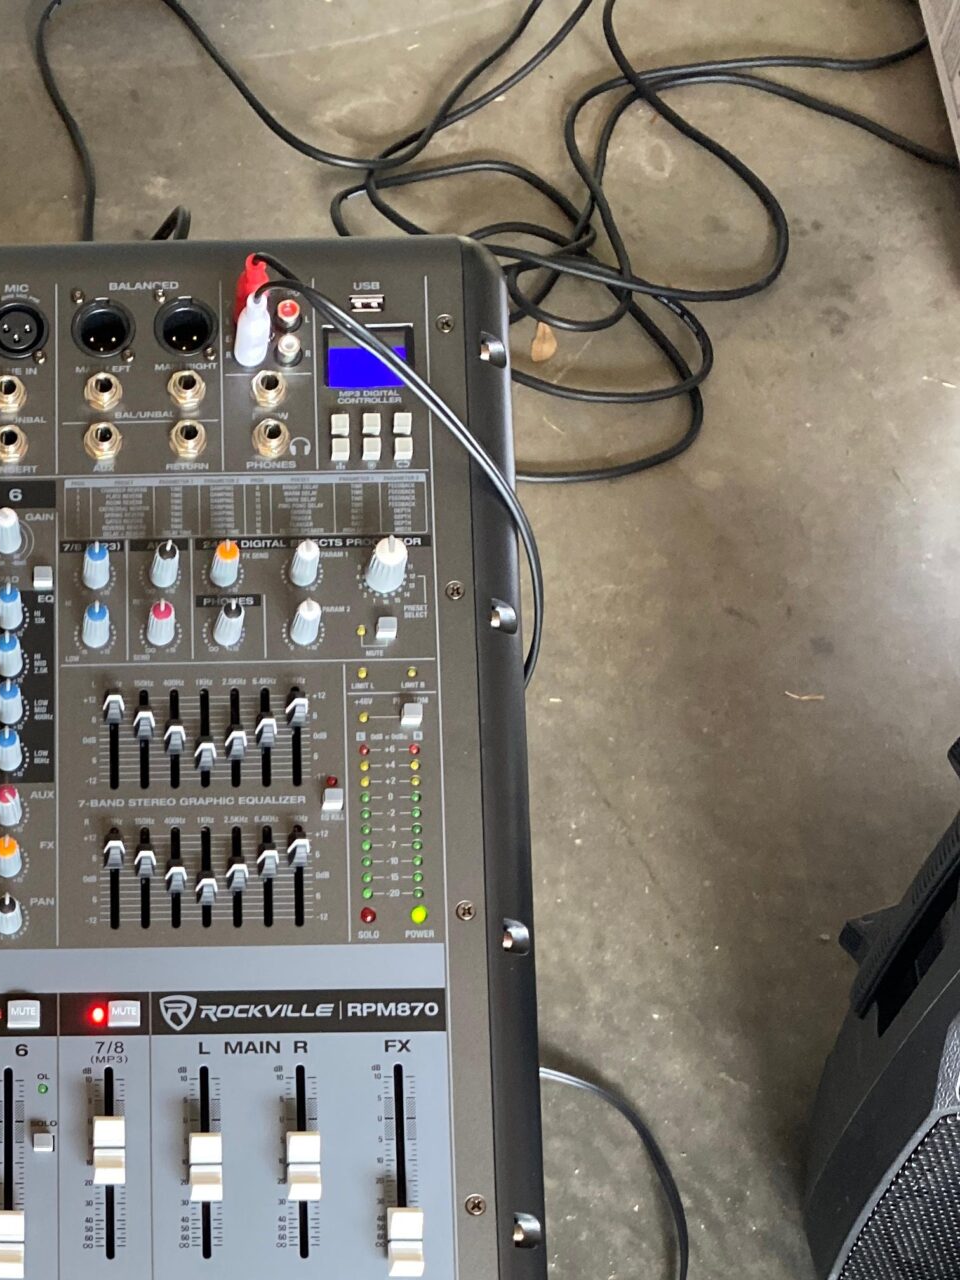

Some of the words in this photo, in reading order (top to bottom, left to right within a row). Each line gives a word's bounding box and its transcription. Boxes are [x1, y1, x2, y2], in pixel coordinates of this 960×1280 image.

[4, 284, 29, 293] MIC
[108, 281, 179, 291] BALANCED
[353, 281, 380, 290] USB
[339, 390, 361, 398] MP3
[362, 390, 399, 398] DIGITAL
[337, 396, 402, 404] CONTROLLER
[93, 463, 115, 472] AUX
[165, 462, 209, 471] RETURN
[246, 461, 296, 470] PHONES
[9, 489, 22, 501] 6
[25, 513, 54, 521] GAIN
[241, 539, 286, 548] DIGITAL
[37, 595, 54, 604] EQ
[30, 790, 54, 799] AUX
[78, 798, 125, 808] 7-BAND
[128, 797, 176, 807] STEREO
[179, 796, 235, 806] GRAPHIC
[238, 795, 306, 805] EQUALIZER
[40, 841, 54, 849] FX
[29, 897, 55, 906] PAN
[358, 930, 380, 939] SOLO
[405, 930, 435, 938] POWER
[11, 1007, 36, 1016] MUTE
[111, 1007, 137, 1016] MUTE
[199, 1003, 335, 1022] ROCKVILLE
[347, 1002, 439, 1017] RPM870
[15, 1044, 29, 1057] 6
[95, 1041, 125, 1054] 7/8
[199, 1042, 211, 1055] L
[224, 1040, 280, 1054] MAIN
[294, 1040, 308, 1054] R
[384, 1039, 411, 1053] FX
[90, 1055, 128, 1065] (MP3)
